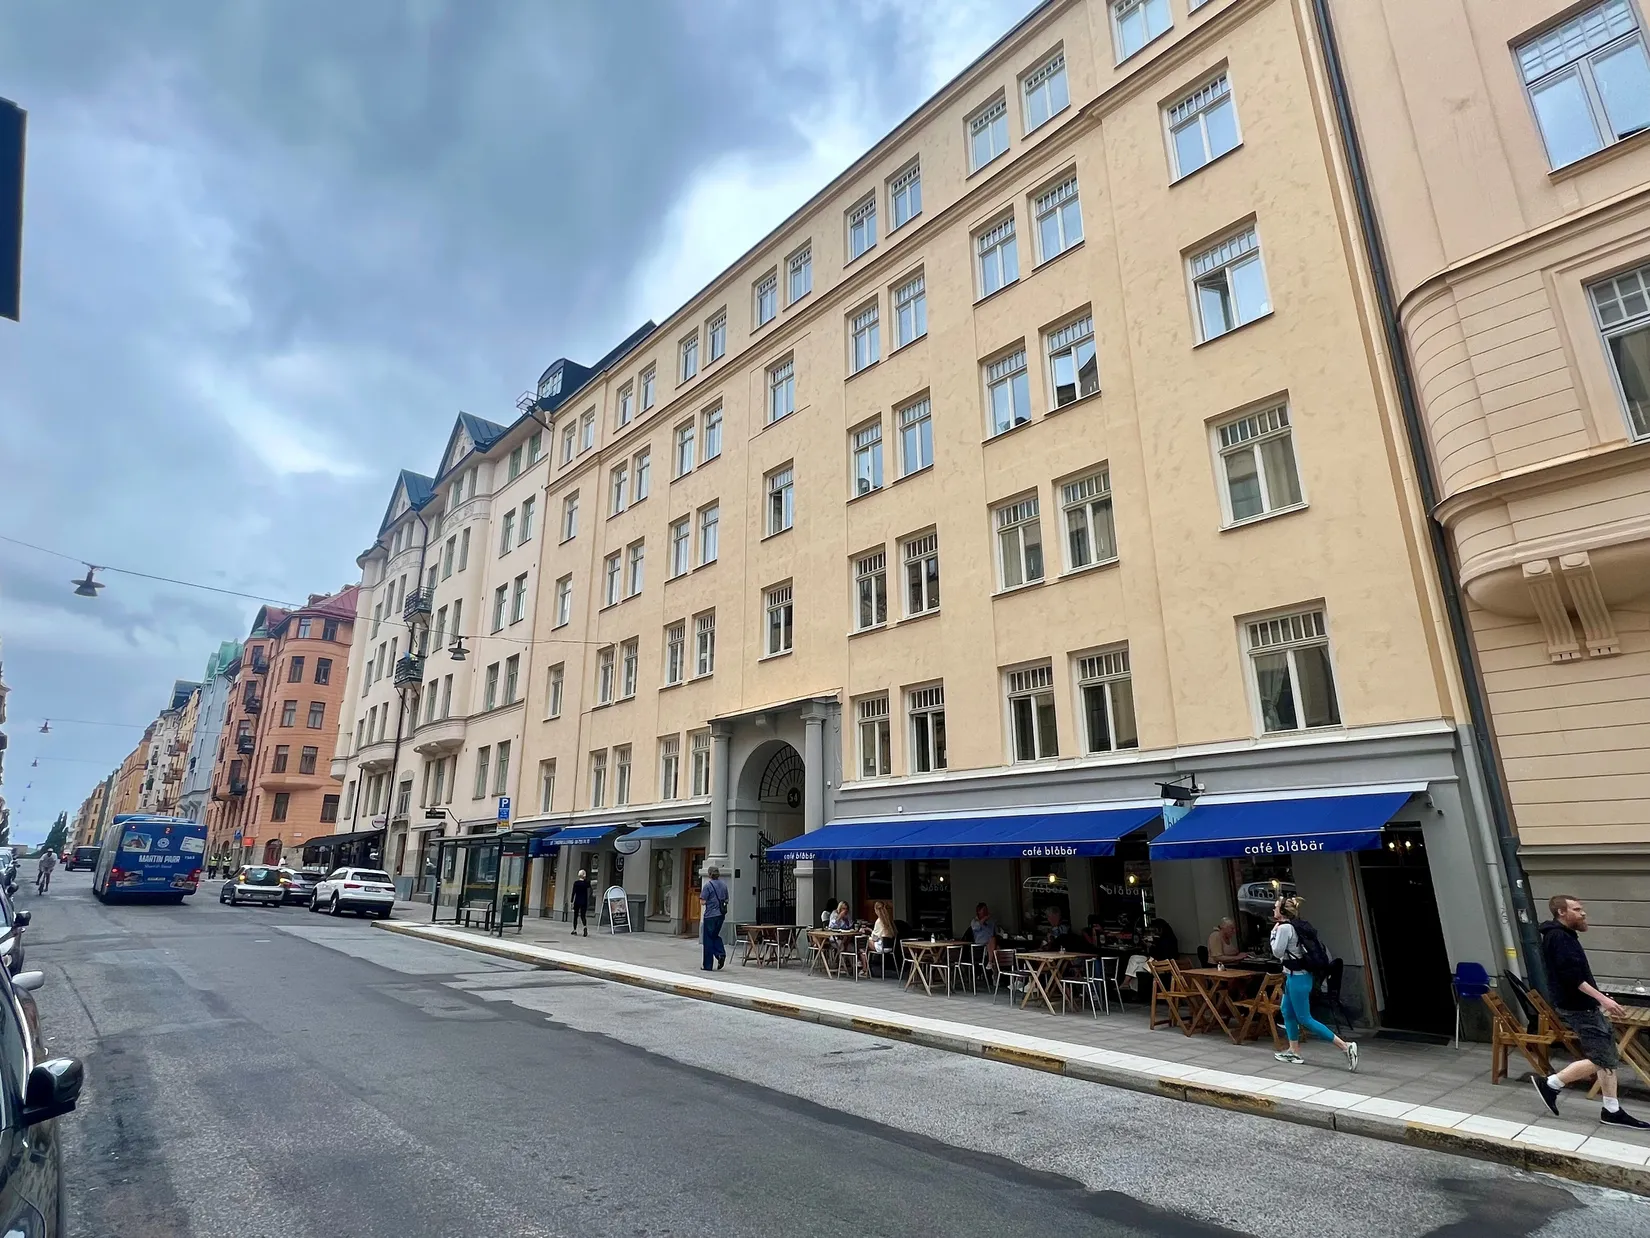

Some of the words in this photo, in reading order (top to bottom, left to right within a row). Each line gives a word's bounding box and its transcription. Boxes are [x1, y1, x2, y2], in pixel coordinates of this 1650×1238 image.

[789, 793, 798, 802] 54
[502, 799, 508, 807] P
[1022, 846, 1042, 856] café
[1044, 845, 1077, 856] blåbär
[1244, 842, 1273, 854] café
[1277, 840, 1324, 853] blåbär
[139, 855, 164, 863] MARTIN
[164, 855, 181, 863] PARR
